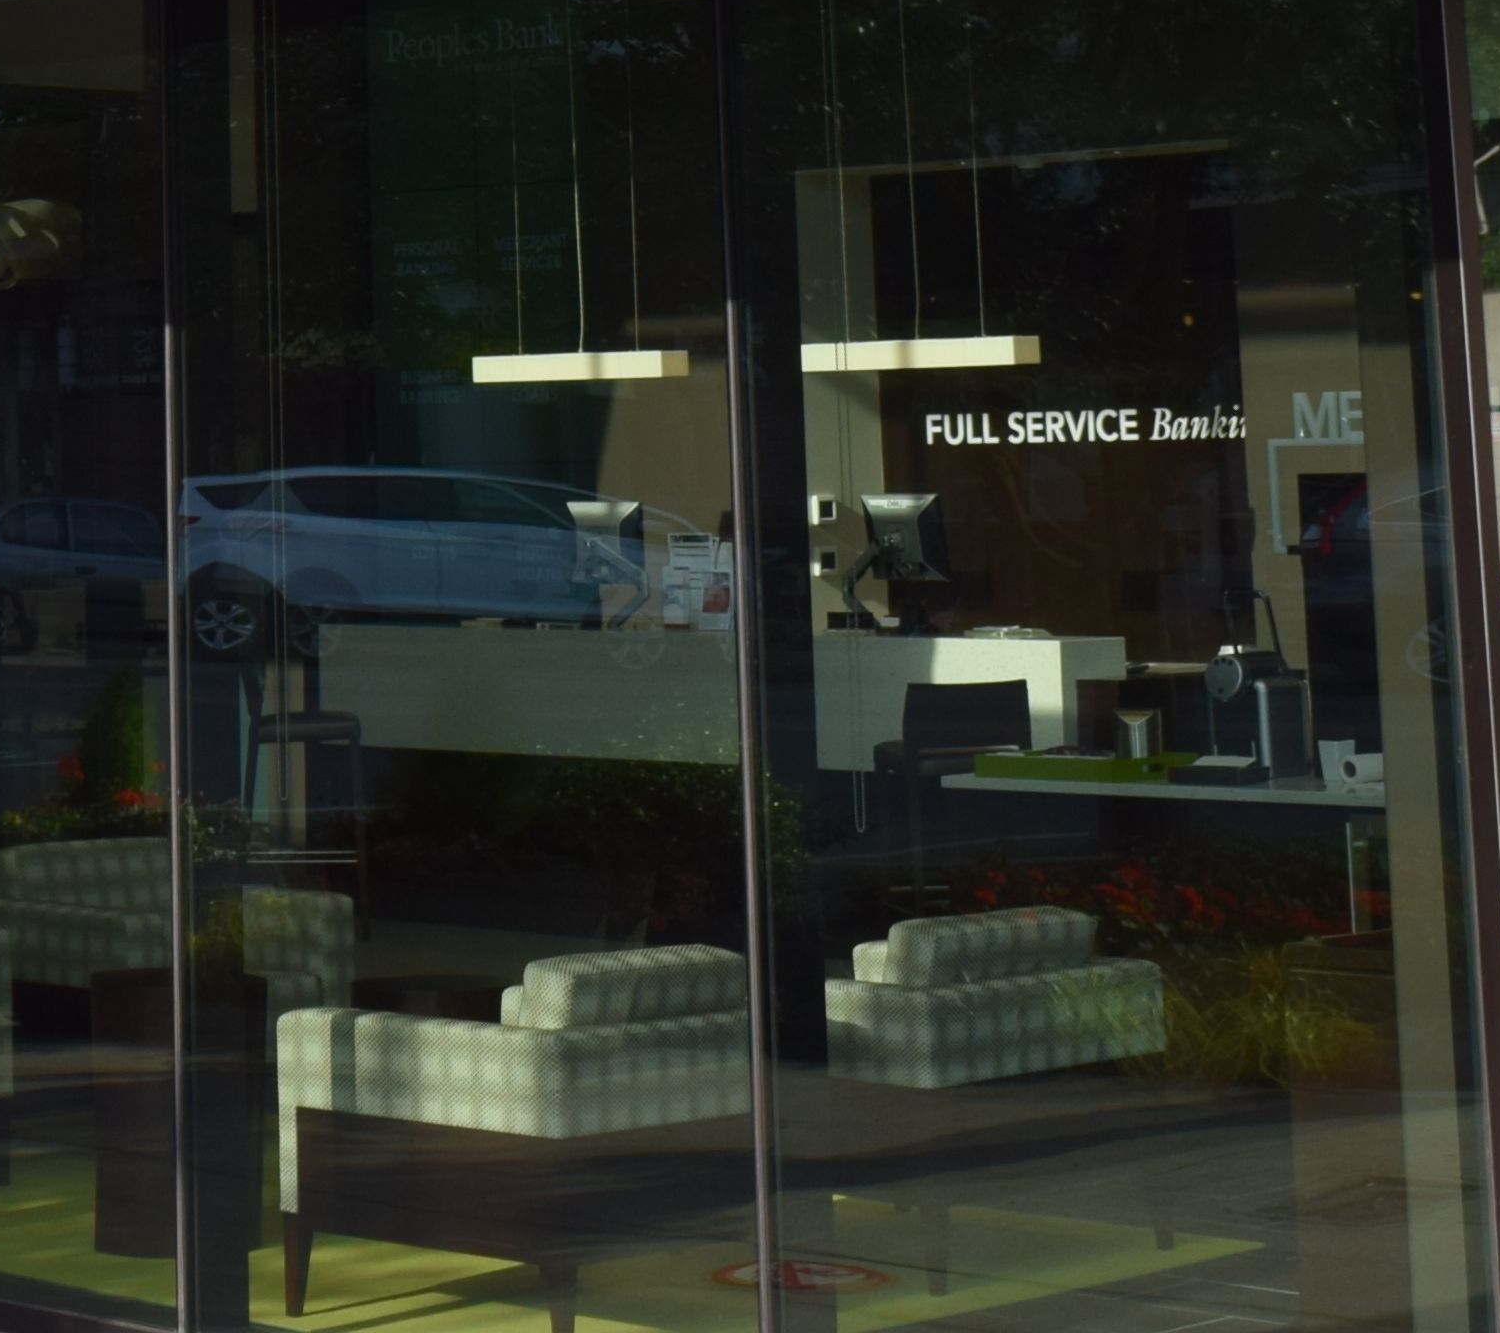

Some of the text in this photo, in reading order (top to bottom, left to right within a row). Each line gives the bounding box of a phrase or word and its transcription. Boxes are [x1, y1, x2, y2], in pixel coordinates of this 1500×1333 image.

[925, 412, 1000, 446] FULL
[1007, 408, 1140, 445] SERVICE
[1292, 390, 1364, 439] ME
